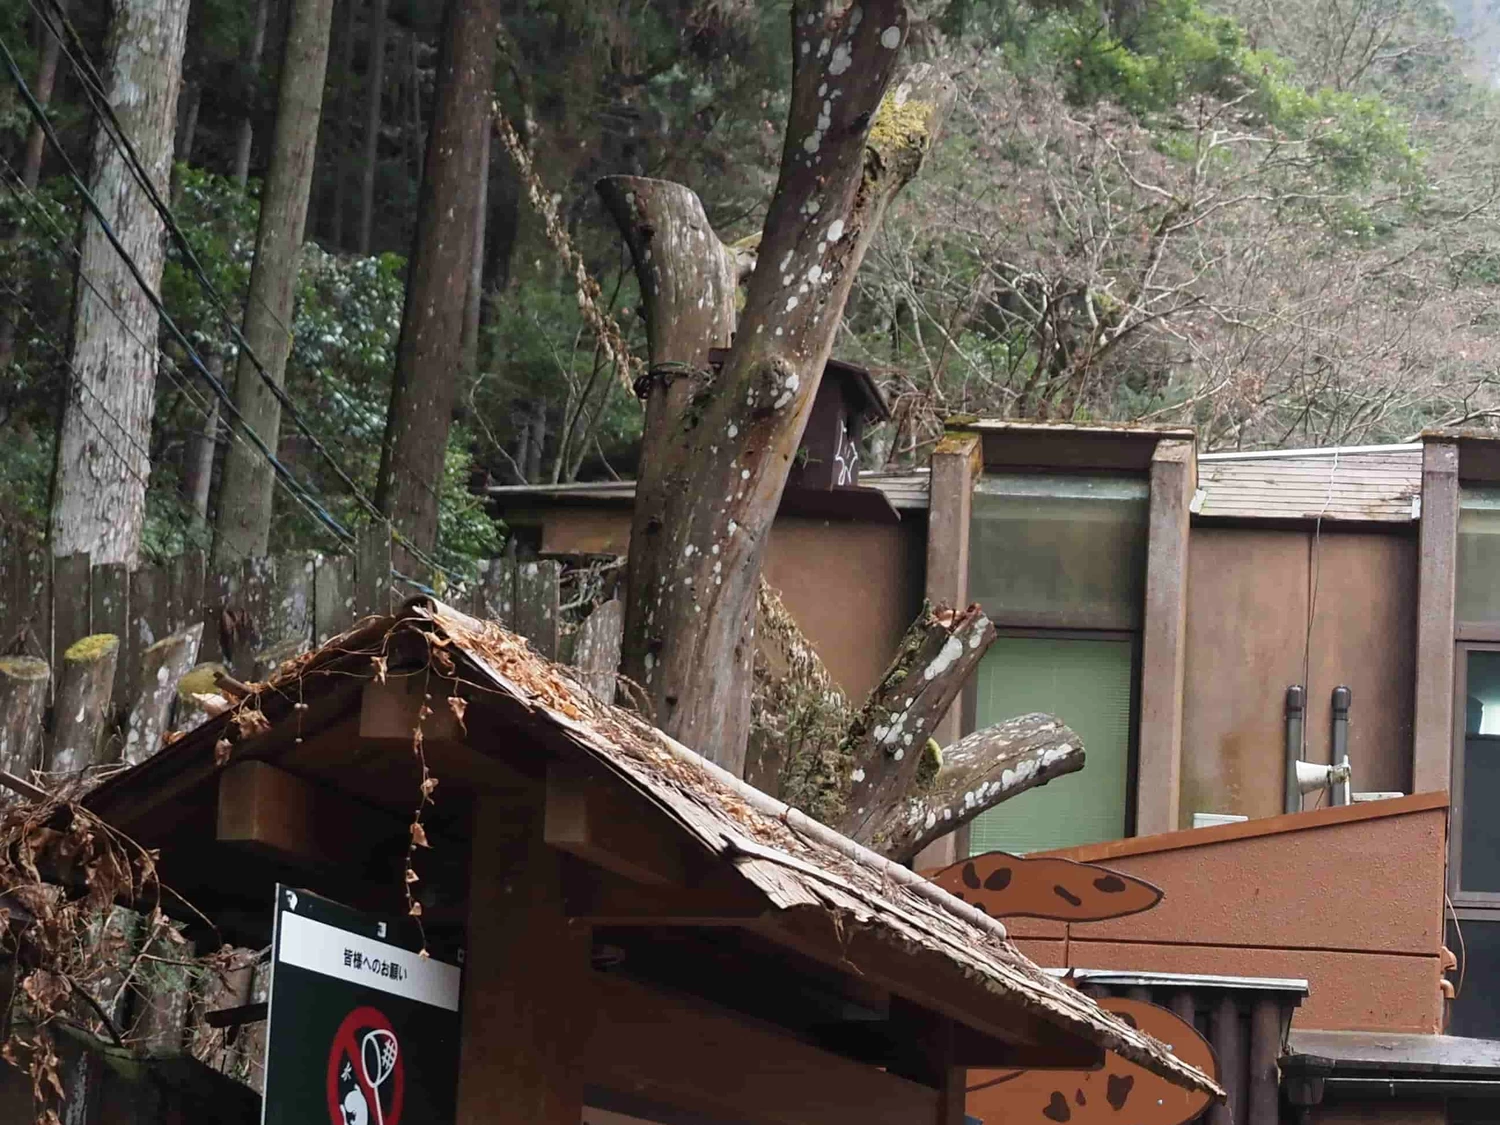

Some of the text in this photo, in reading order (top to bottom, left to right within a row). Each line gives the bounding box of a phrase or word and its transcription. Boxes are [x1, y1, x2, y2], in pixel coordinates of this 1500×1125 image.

[343, 948, 408, 982] 皆様へのお願い
